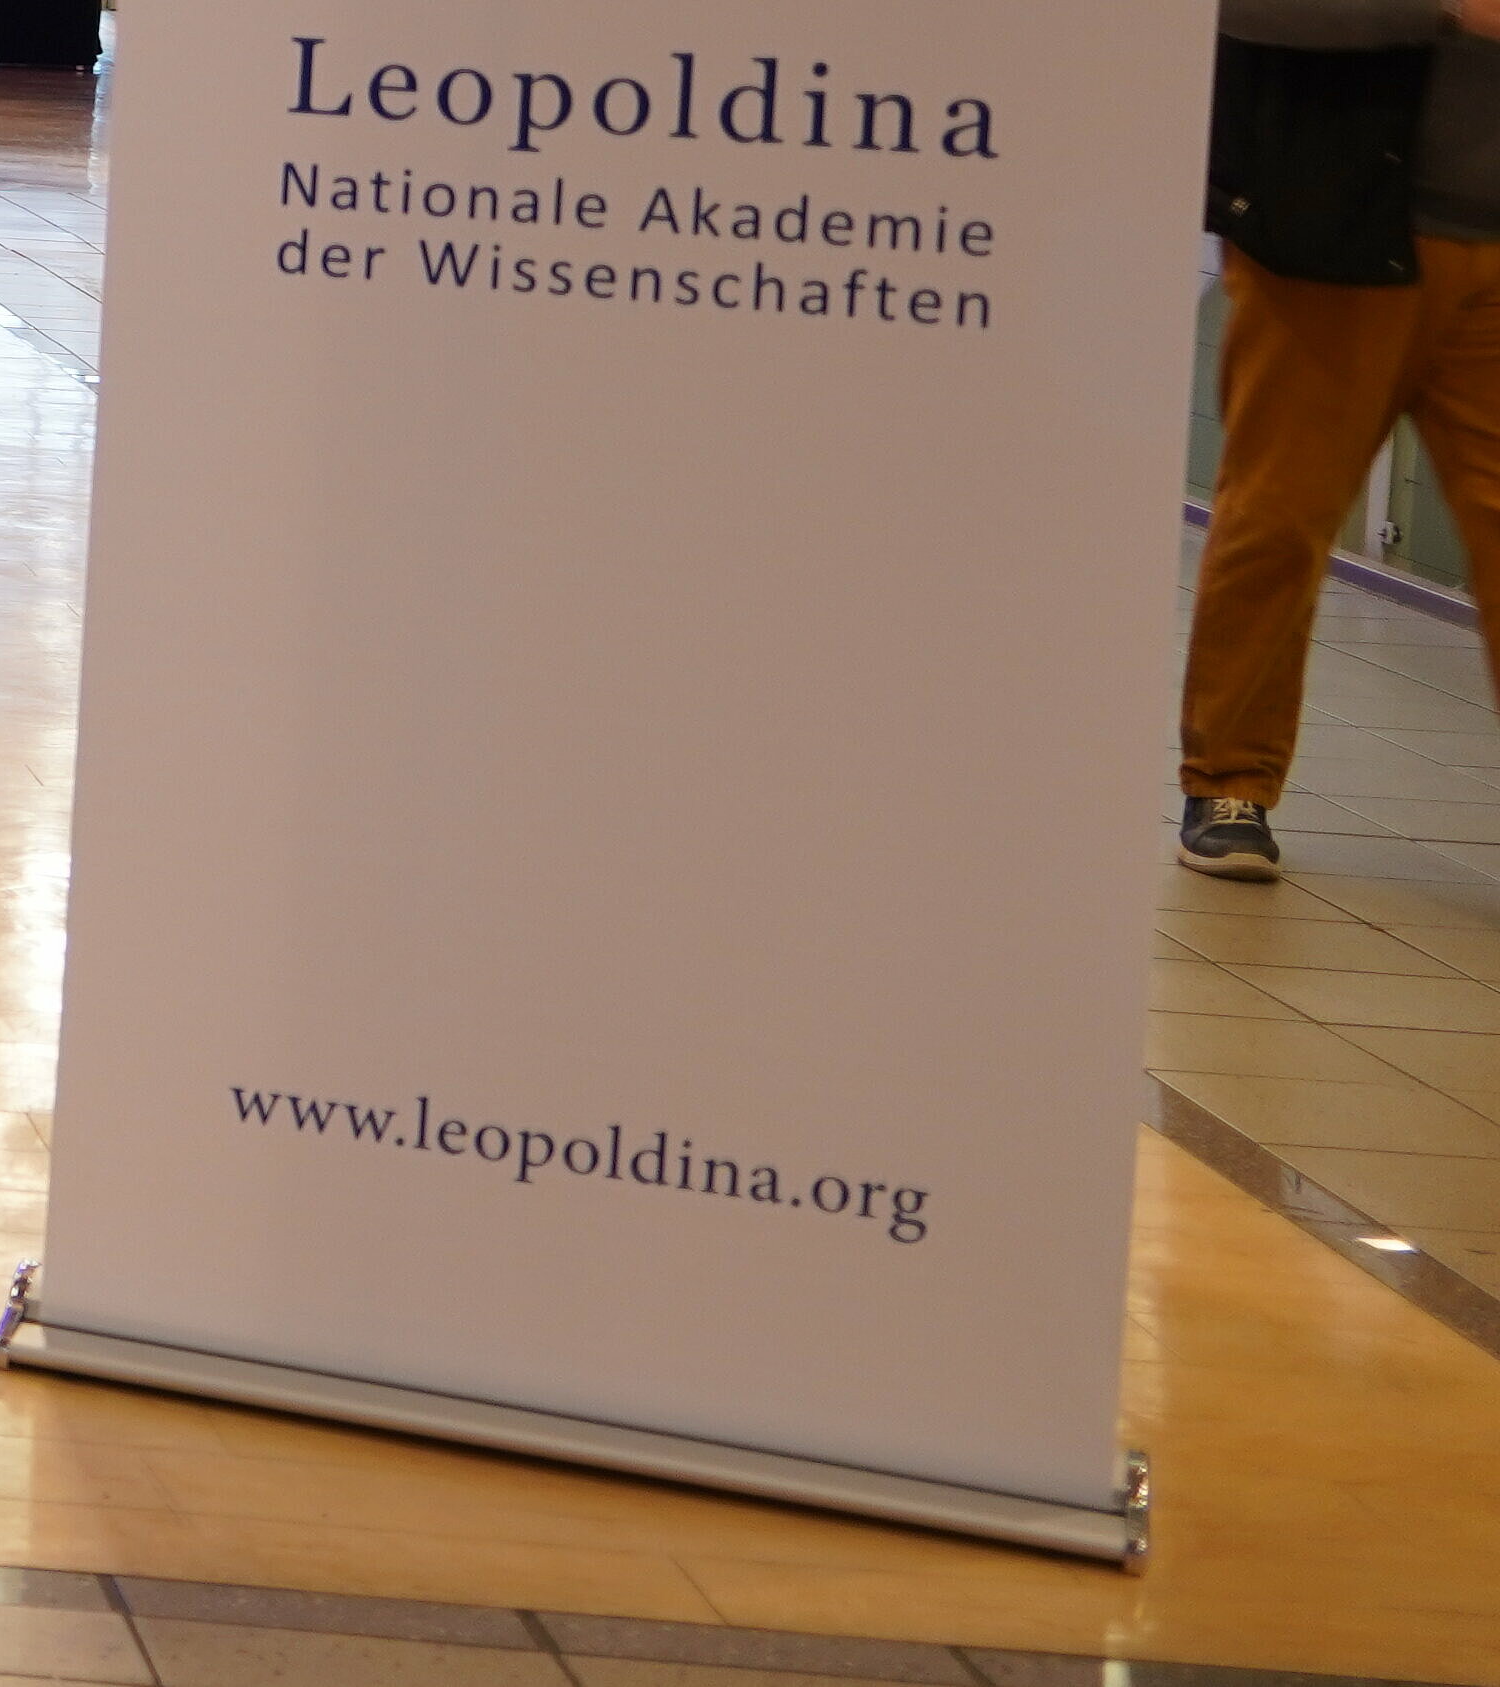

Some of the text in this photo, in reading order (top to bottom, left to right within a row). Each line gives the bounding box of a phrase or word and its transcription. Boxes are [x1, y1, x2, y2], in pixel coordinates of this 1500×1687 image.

[286, 36, 1000, 159] Leopoldina
[279, 162, 995, 257] Nationale Akademie
[276, 228, 991, 330] der Wissenschaften
[230, 1085, 929, 1245] www.leopoldina.org
